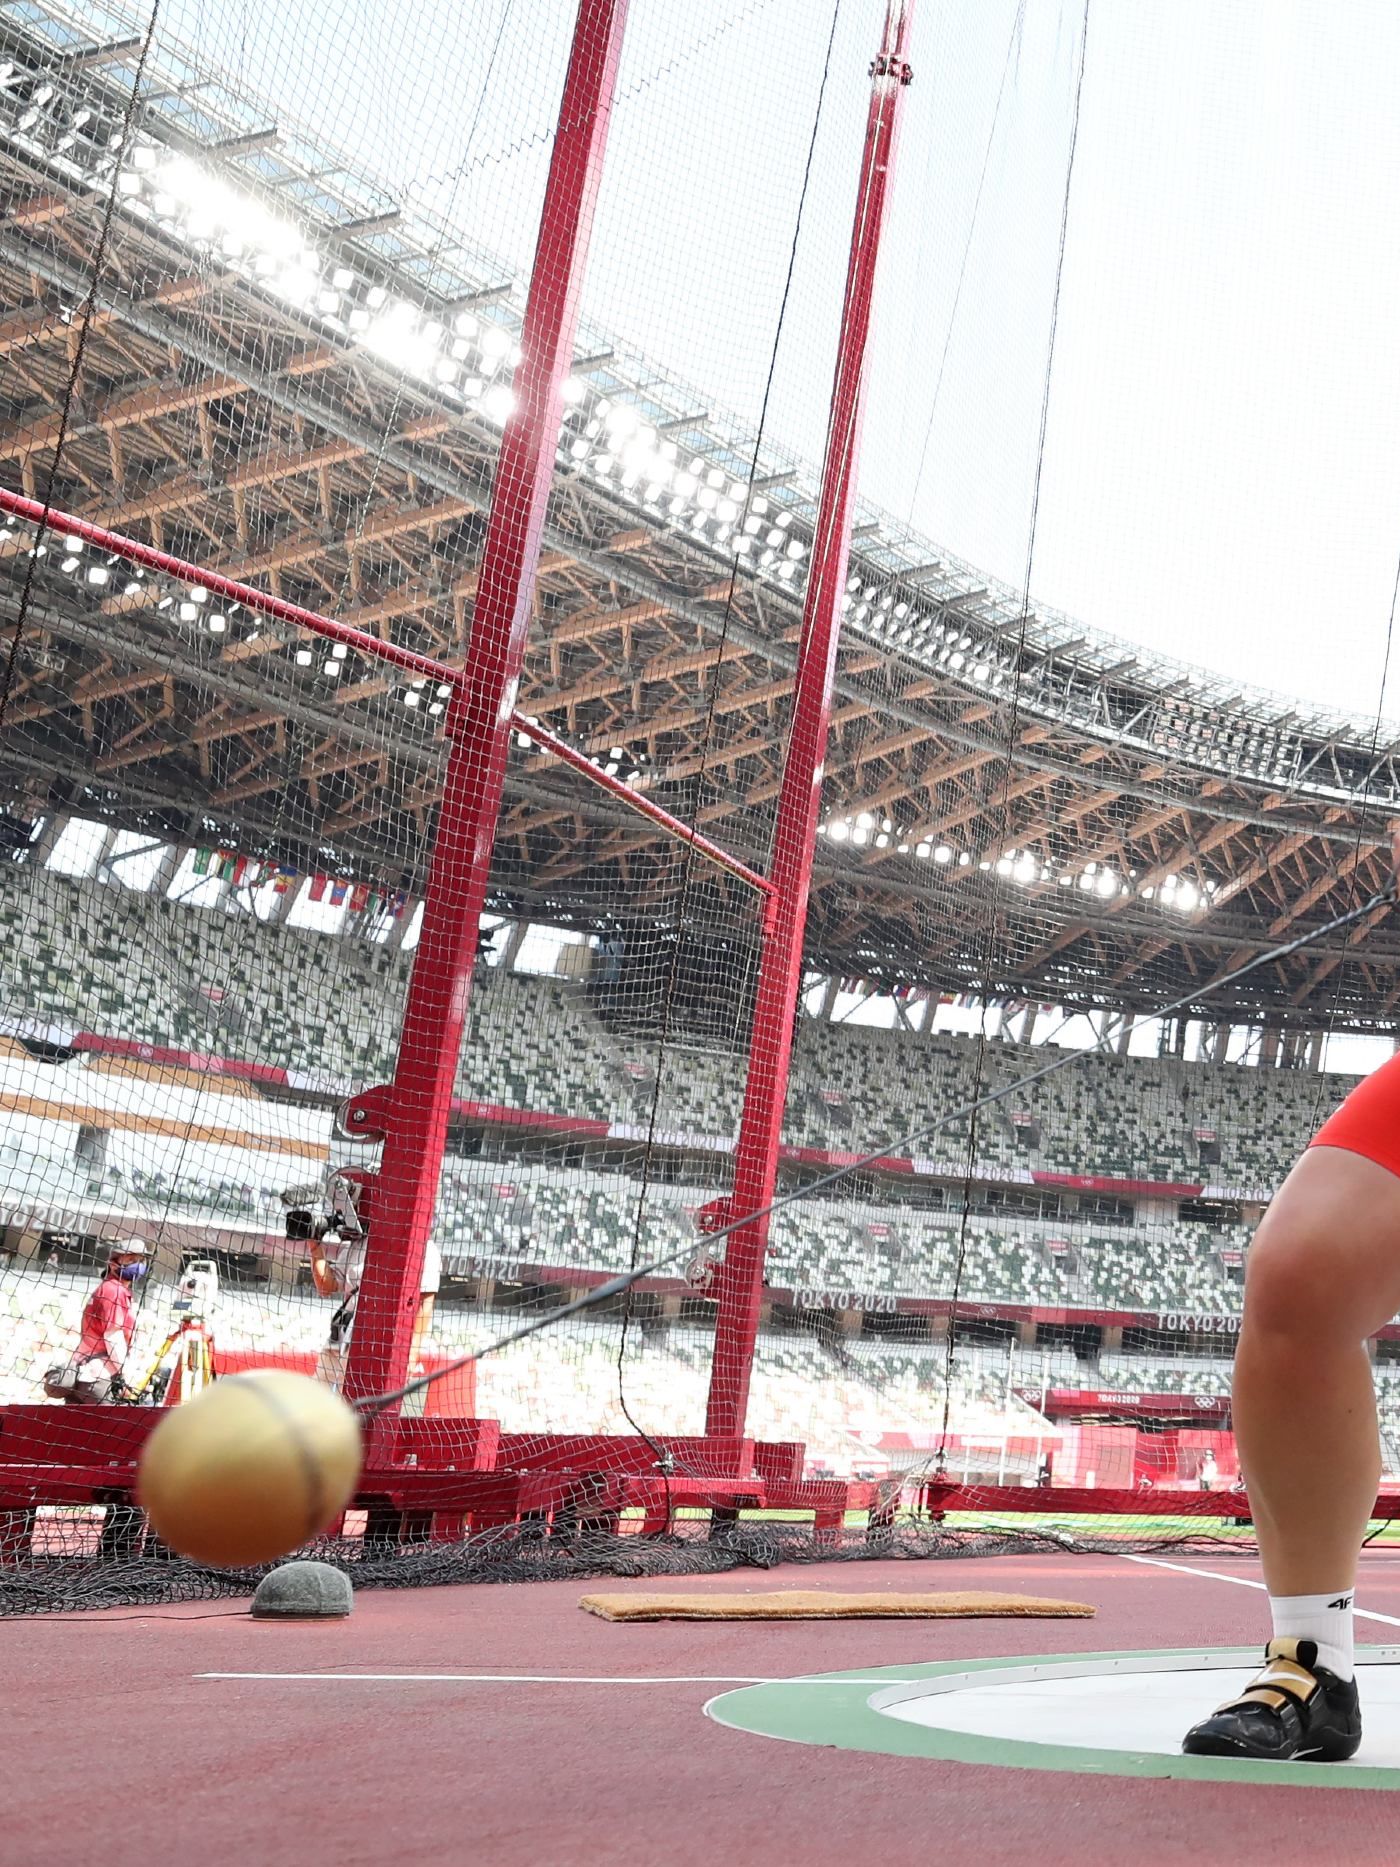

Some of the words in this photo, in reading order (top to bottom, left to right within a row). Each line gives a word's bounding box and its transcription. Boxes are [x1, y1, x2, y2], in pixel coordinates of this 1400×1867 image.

[792, 1287, 849, 1311] TOKYO
[853, 1294, 896, 1313] 2020
[1157, 1313, 1213, 1332] TOKYO
[1216, 1316, 1242, 1333] 20
